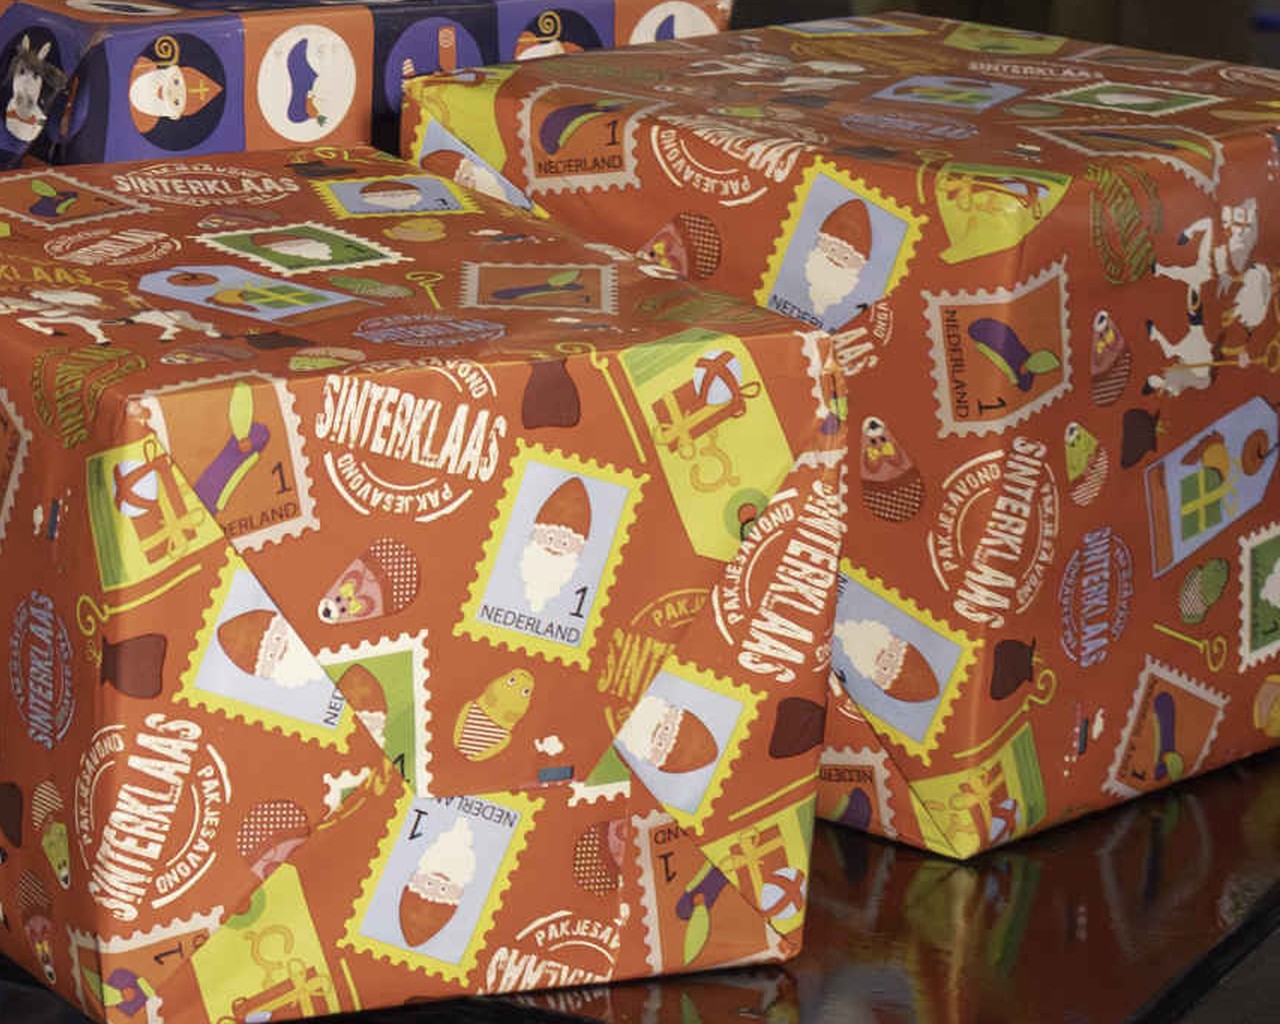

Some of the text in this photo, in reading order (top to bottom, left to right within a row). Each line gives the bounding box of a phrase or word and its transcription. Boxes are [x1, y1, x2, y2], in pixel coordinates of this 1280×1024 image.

[607, 119, 620, 147] 1
[112, 174, 301, 196] SINTERKLAAS
[539, 154, 624, 175] NEDERLAND
[943, 308, 970, 418] NEDERLAND
[315, 374, 508, 483] SINTERKLAAS
[976, 396, 1008, 415] 1
[271, 461, 290, 495] 1
[337, 452, 454, 514] PAKJESAVOND
[952, 435, 1048, 629] SINTERKLAAS
[723, 501, 796, 626] PAKJESAVOND
[738, 479, 847, 684] SINTERKLAAS
[568, 587, 587, 618] 1
[1080, 527, 1111, 668] SINTERKLAAS
[478, 603, 581, 644] NEDERLAND
[27, 588, 55, 751] SINTERKLAAS
[89, 713, 203, 921] SINTERKLAAS
[153, 764, 221, 894] PAKJESAVOND
[408, 808, 429, 841] 1
[656, 852, 676, 882] 1
[152, 942, 183, 966] 1
